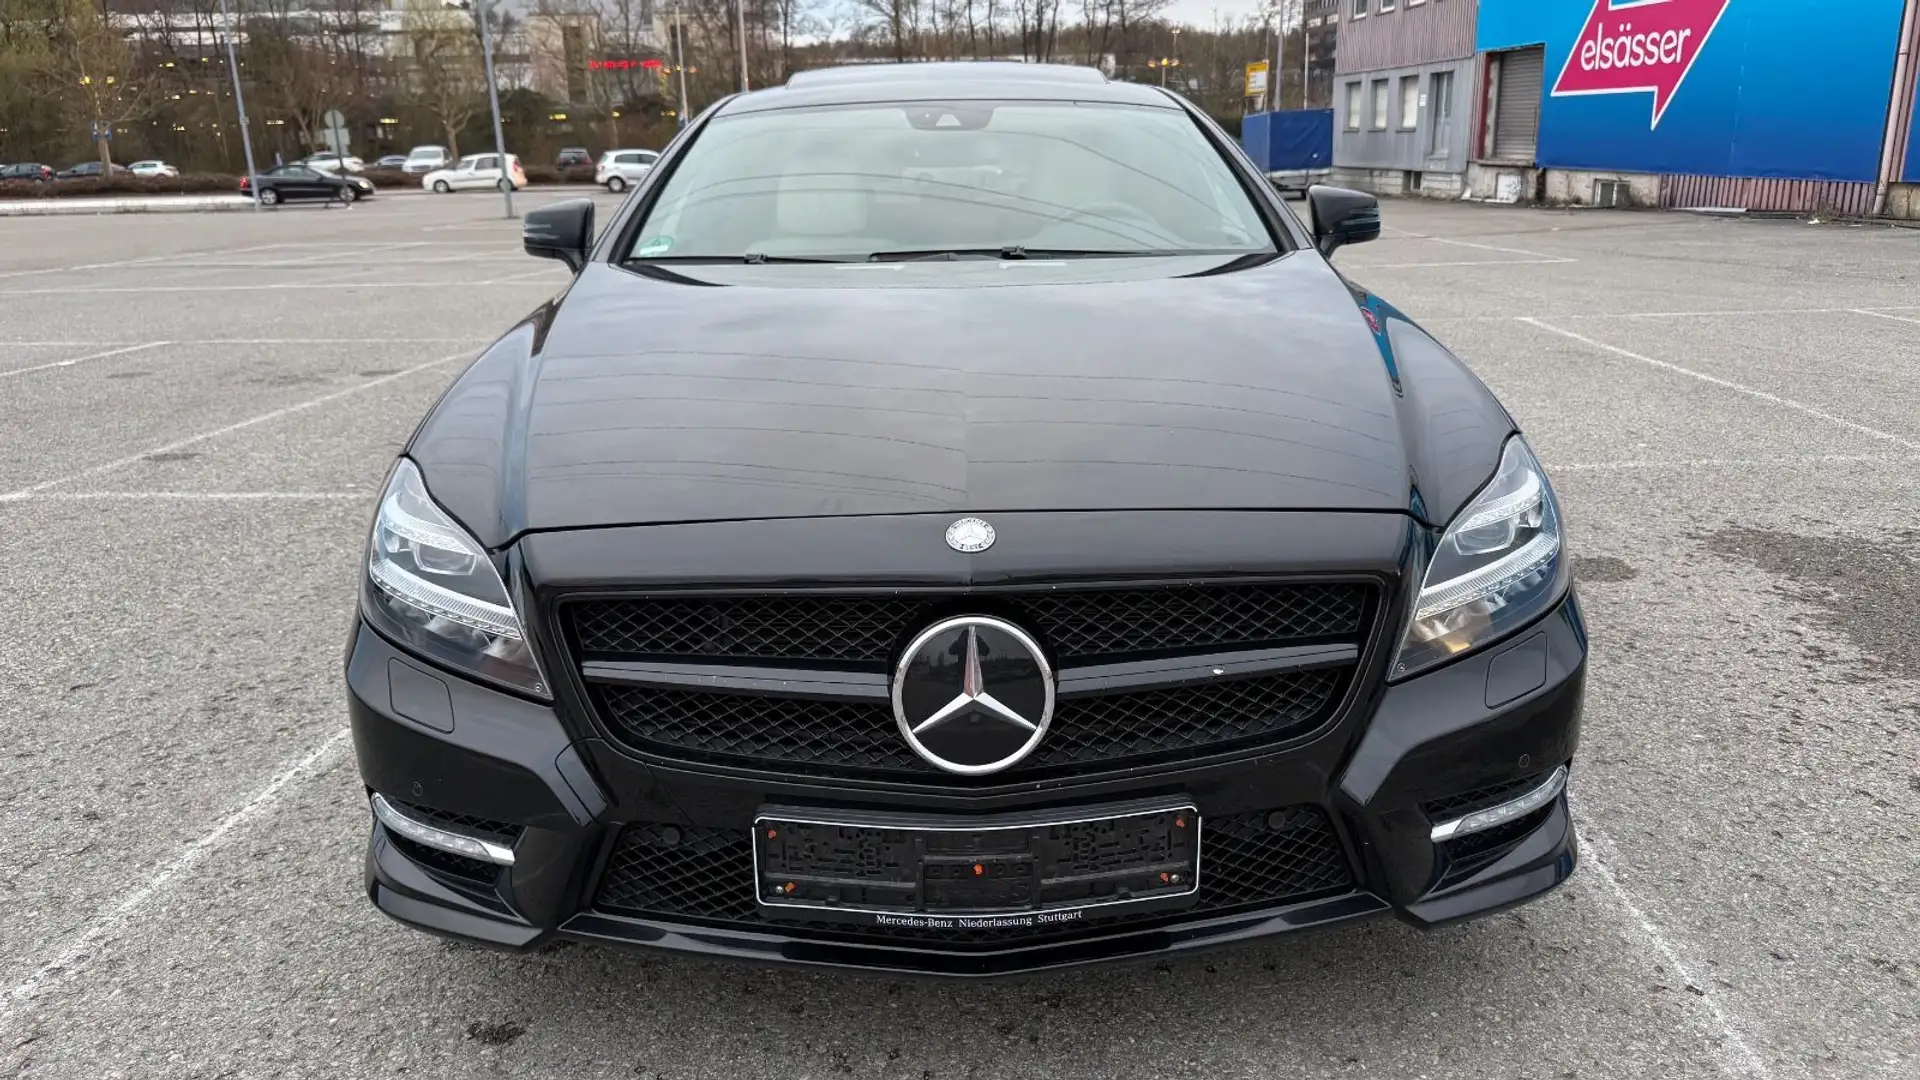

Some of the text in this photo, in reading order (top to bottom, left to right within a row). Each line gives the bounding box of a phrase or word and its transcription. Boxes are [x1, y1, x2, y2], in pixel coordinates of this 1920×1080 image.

[1581, 23, 1691, 71] elsässer
[876, 910, 1083, 928] Mercedes-Benz Niederlassung Stuttgart
